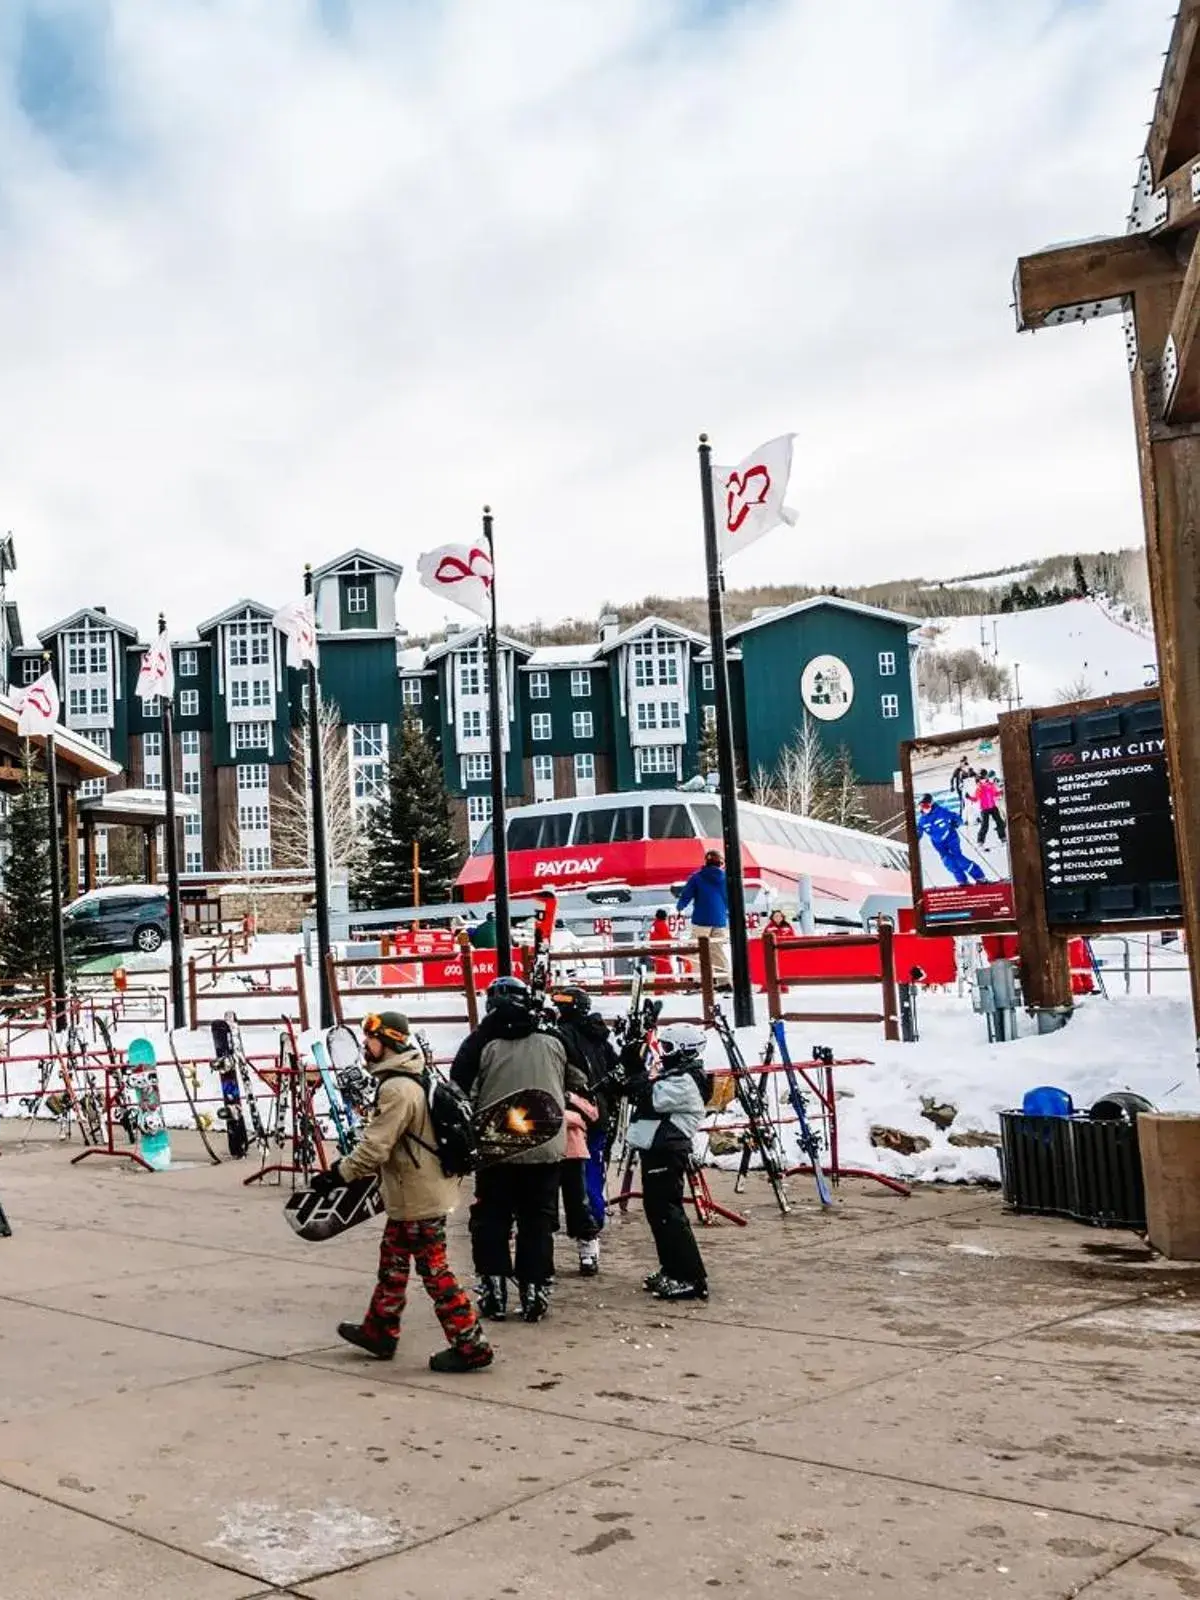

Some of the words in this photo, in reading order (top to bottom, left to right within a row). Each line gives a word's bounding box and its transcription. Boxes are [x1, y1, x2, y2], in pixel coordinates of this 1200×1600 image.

[1081, 746, 1122, 762] PARK
[1127, 739, 1166, 755] CITY
[1075, 769, 1121, 780] SNOWBOARD
[1121, 764, 1153, 776] SCHOOL
[1057, 781, 1089, 792] MEETING
[1090, 779, 1109, 788] AREA
[1070, 793, 1091, 802] VALET
[1059, 805, 1097, 815] MOUNTAIN
[1097, 801, 1130, 811] COASTER
[1060, 823, 1085, 833] FLYING
[1086, 821, 1108, 830] EAGLE
[1109, 817, 1136, 827] ZIPLINE
[1062, 836, 1084, 845] GUEST
[1085, 833, 1120, 843] SERVICES
[1062, 848, 1088, 857] RENTAL
[1095, 845, 1120, 854] REPAIR
[534, 857, 603, 877] PAYDAY
[1063, 861, 1089, 870] RENTAL
[1090, 858, 1123, 868] LOCKERS
[1063, 872, 1108, 882] RESTROOMS
[472, 963, 495, 974] ARK
